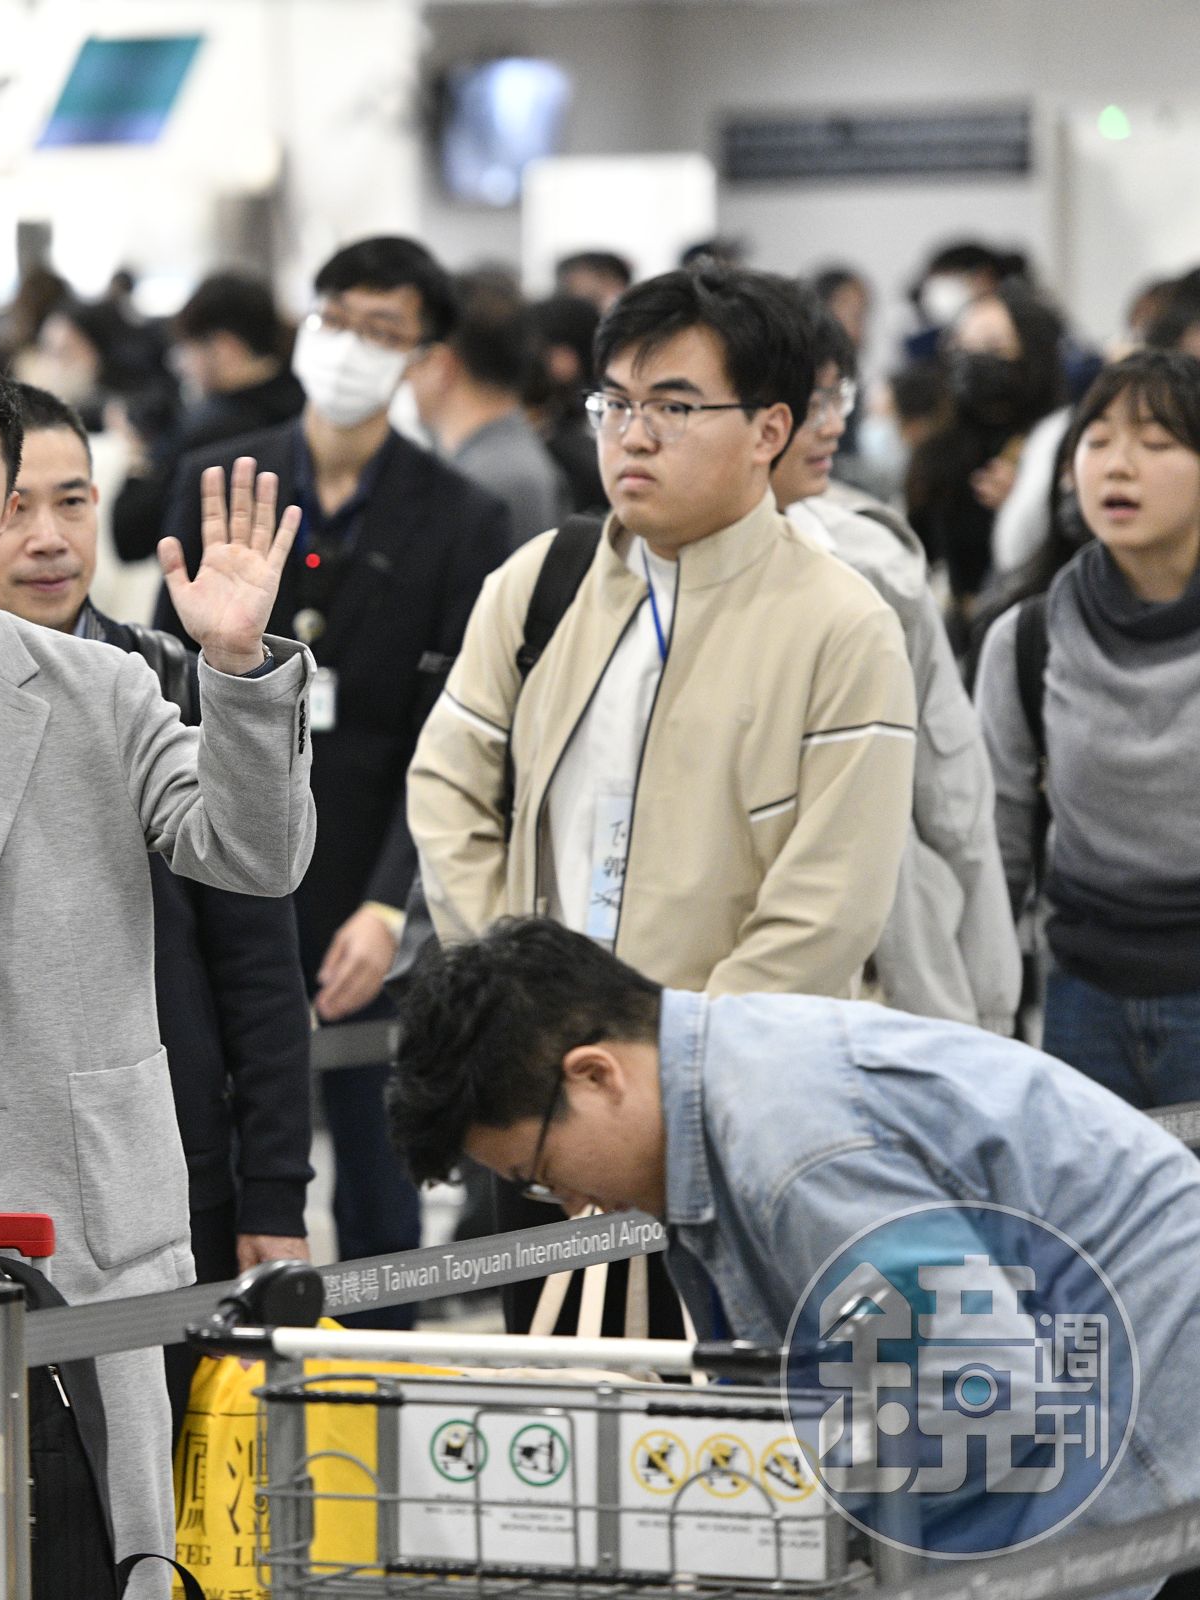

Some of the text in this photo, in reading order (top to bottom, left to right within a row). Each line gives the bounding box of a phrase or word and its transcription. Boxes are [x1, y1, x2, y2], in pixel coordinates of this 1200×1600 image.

[381, 1263, 440, 1293] Taiwan
[442, 1250, 512, 1286] Taoyuan
[516, 1222, 616, 1268] International
